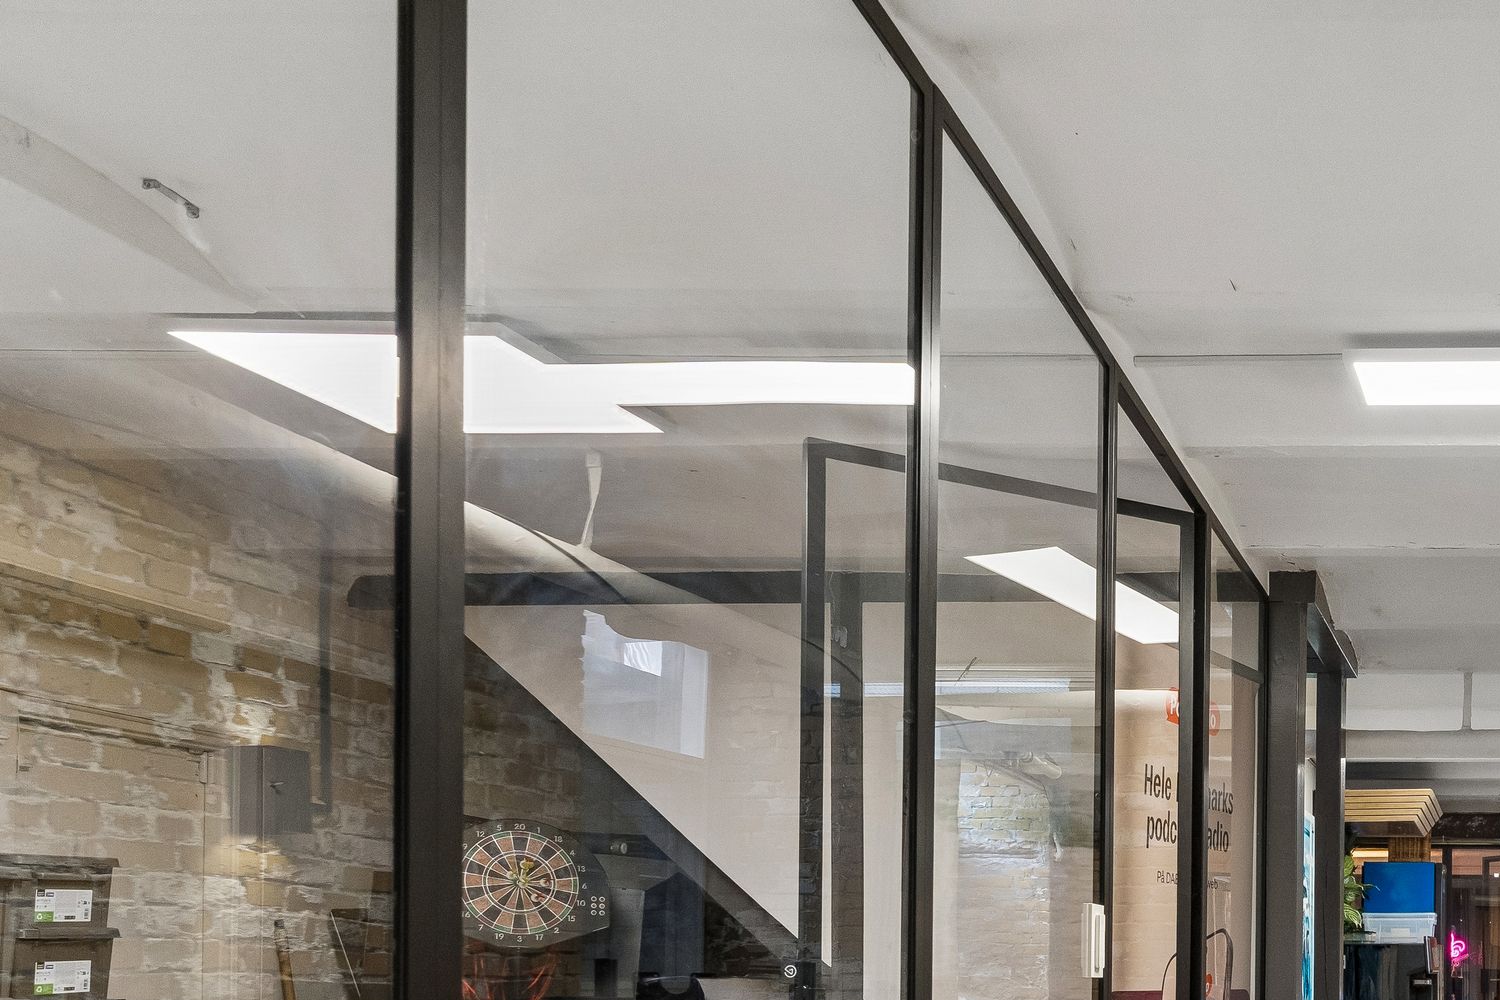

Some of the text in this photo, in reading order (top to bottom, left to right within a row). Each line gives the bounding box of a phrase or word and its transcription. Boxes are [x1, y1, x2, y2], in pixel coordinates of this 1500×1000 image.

[1144, 763, 1172, 800] Hele
[514, 823, 526, 831] 20
[1146, 811, 1178, 849] podc
[577, 865, 586, 873] 13
[494, 932, 504, 940] 19
[535, 931, 544, 940] 17
